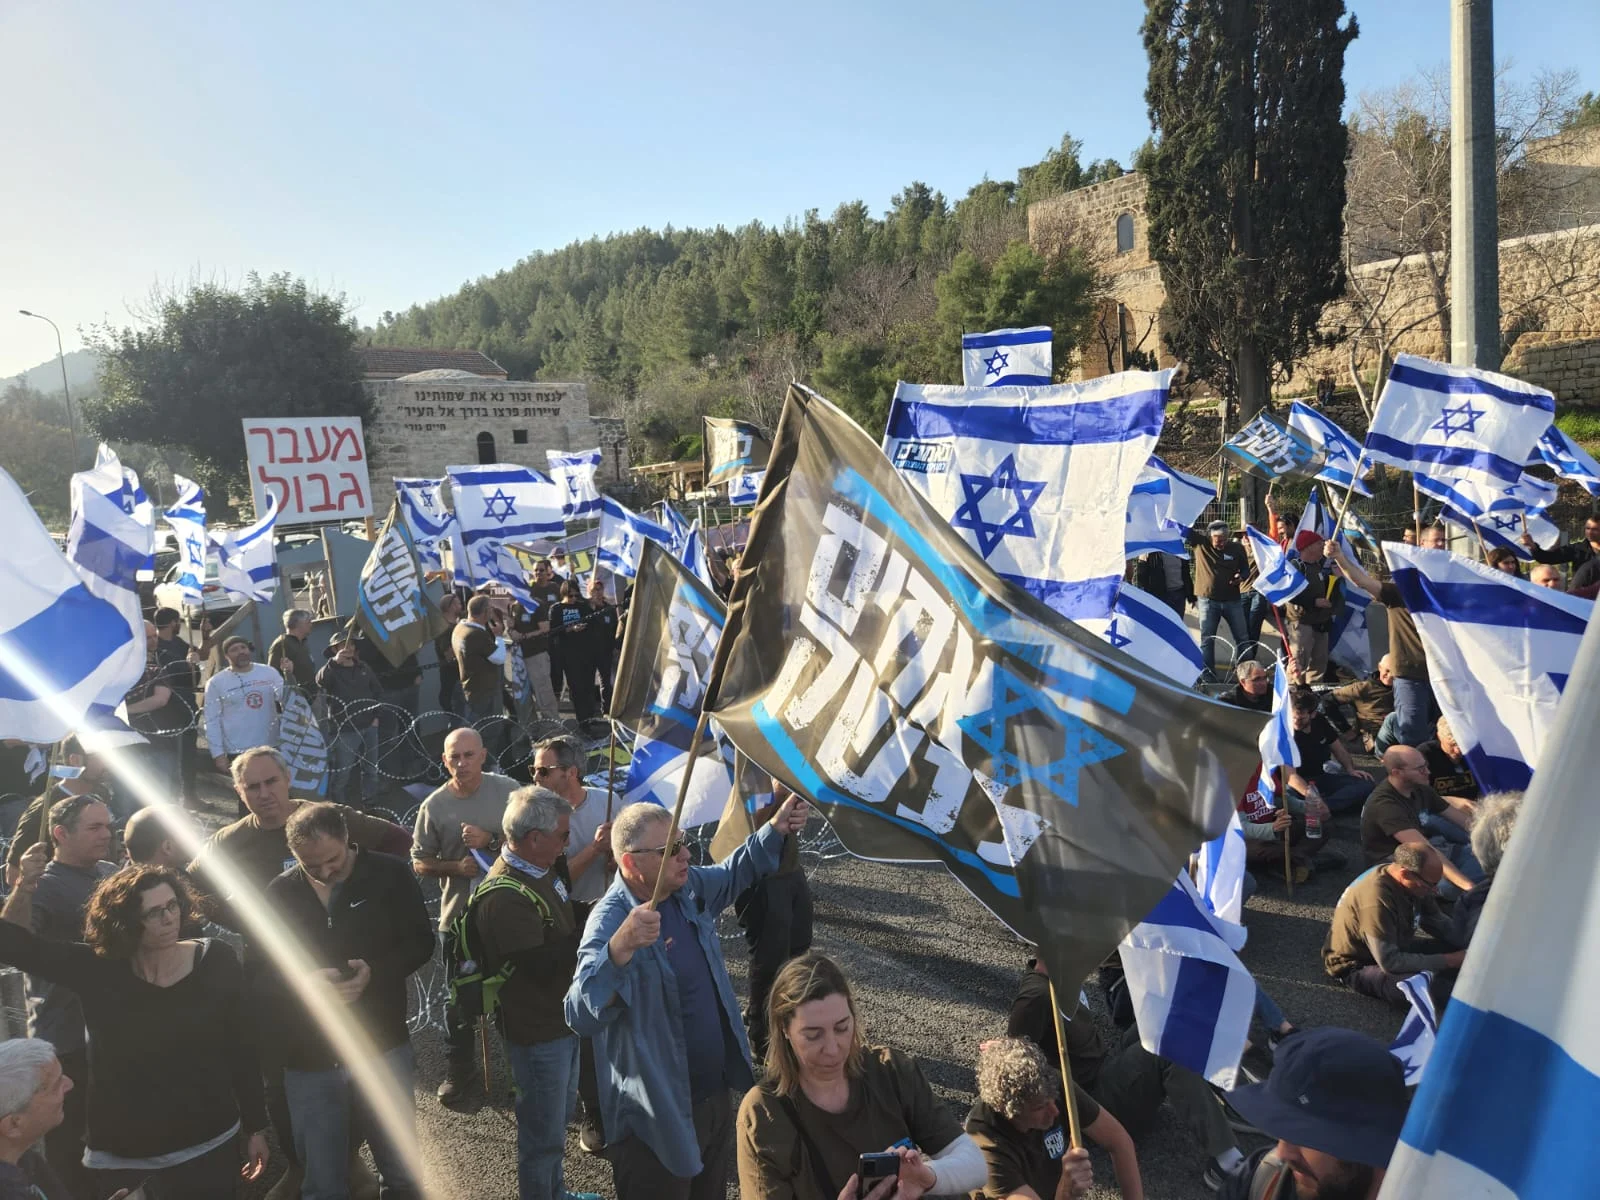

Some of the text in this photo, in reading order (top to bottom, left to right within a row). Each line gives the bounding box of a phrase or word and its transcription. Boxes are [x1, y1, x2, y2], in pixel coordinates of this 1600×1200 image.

[415, 390, 464, 401] שמותינו
[470, 391, 486, 401] את
[491, 391, 504, 401] נא
[509, 391, 531, 401] זכור
[437, 405, 454, 416] אל
[459, 406, 487, 419] בדרך
[492, 406, 519, 416] פרצו
[523, 406, 560, 416] שיירות
[425, 423, 446, 431] חיים
[249, 425, 363, 465] מעבר
[257, 466, 365, 514] גבול
[803, 503, 993, 760] אחים
[762, 603, 1051, 869] לנשק
